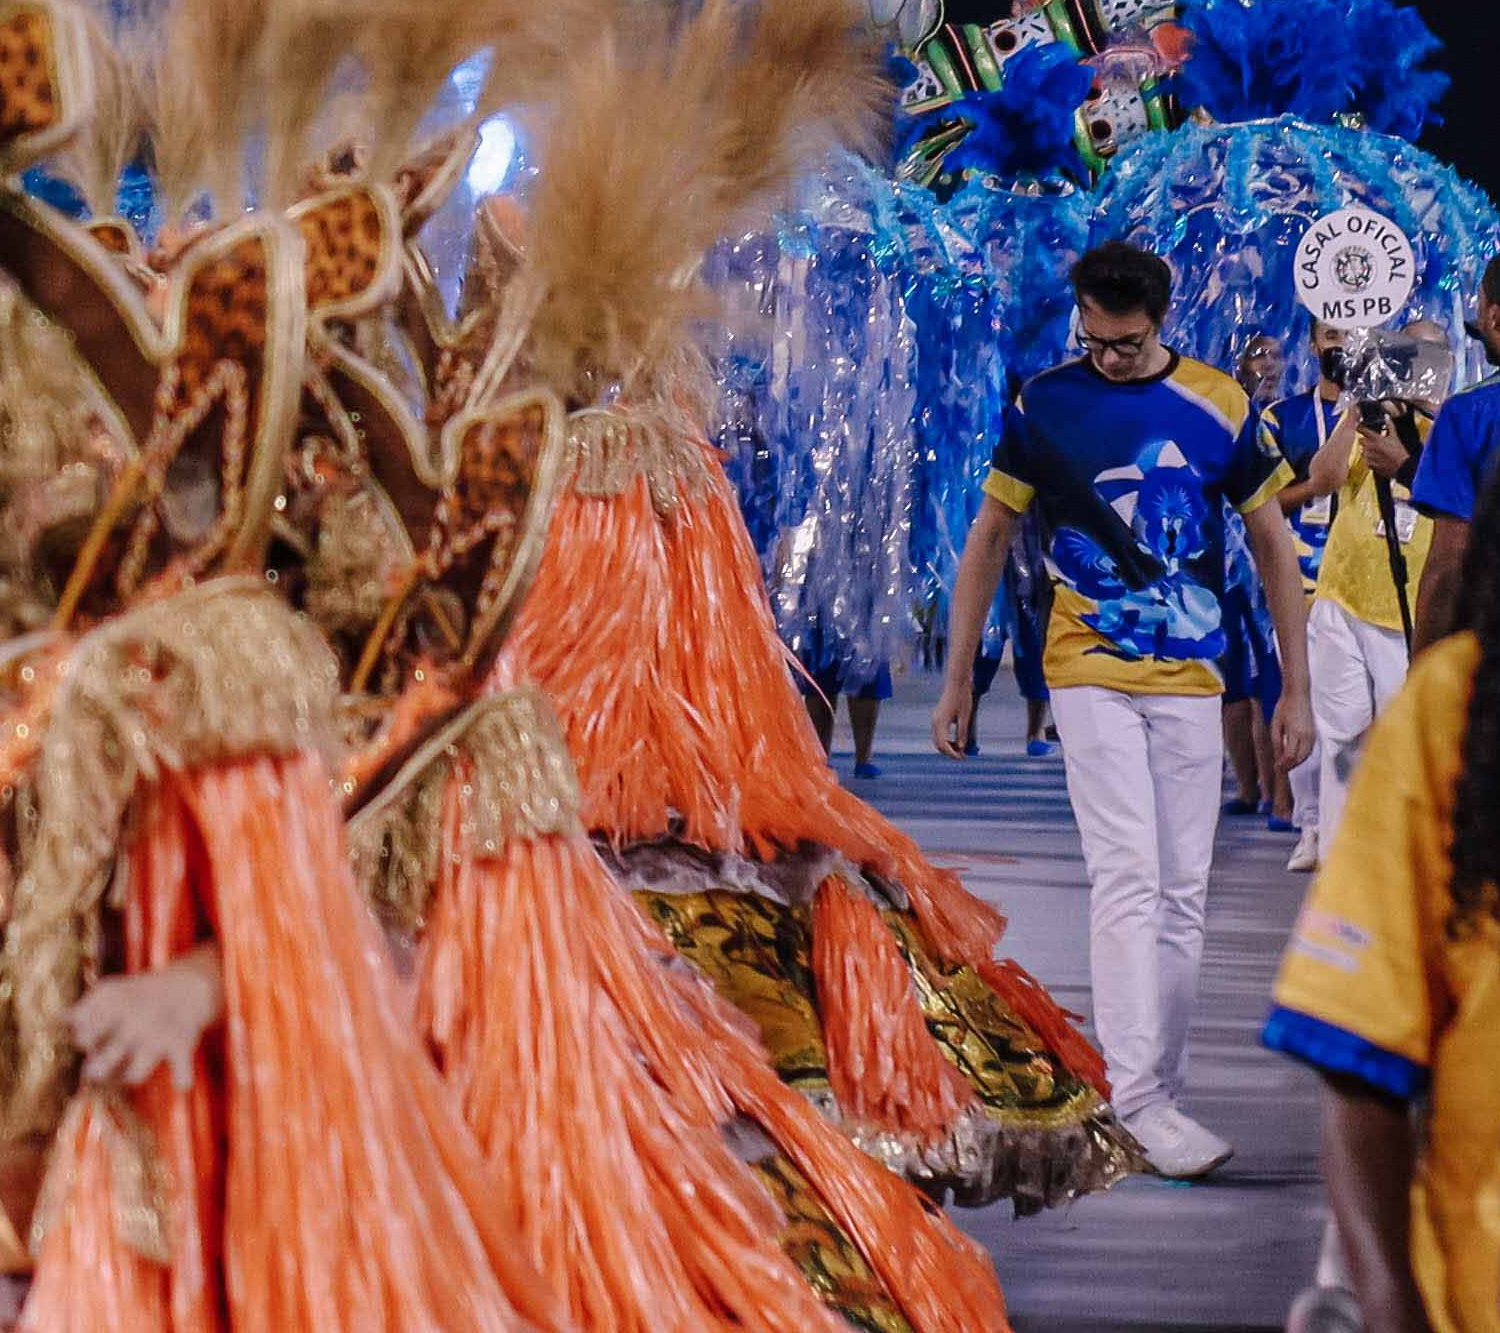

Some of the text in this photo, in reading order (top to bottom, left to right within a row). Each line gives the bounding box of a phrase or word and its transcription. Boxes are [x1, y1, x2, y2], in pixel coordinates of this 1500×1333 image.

[1301, 216, 1406, 289] CASAL OFICIAL
[1322, 297, 1392, 320] MS PB
